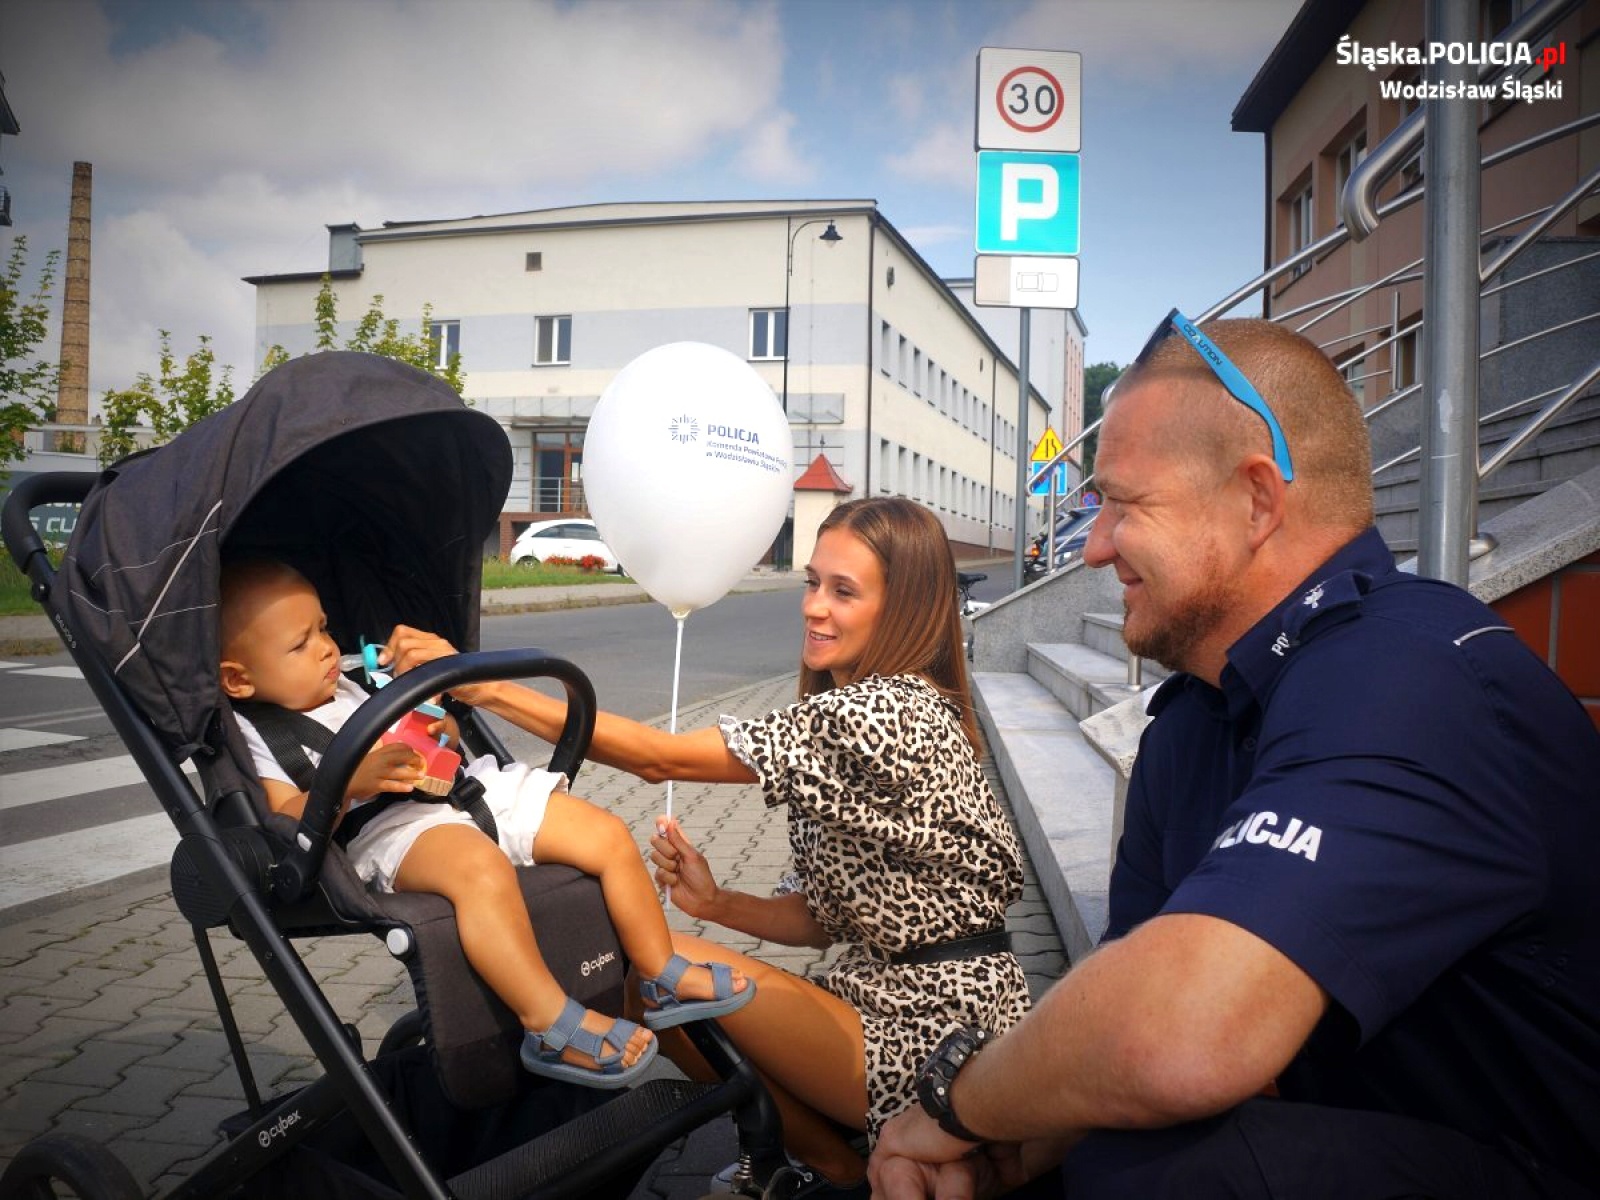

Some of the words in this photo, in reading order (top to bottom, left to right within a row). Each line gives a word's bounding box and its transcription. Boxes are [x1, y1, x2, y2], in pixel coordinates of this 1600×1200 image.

[1008, 83, 1056, 116] 30
[1001, 162, 1060, 241] P
[707, 424, 760, 445] POLICJA
[1271, 632, 1290, 656] PO
[1209, 811, 1323, 862] LICJA
[270, 1110, 302, 1137] cybex
